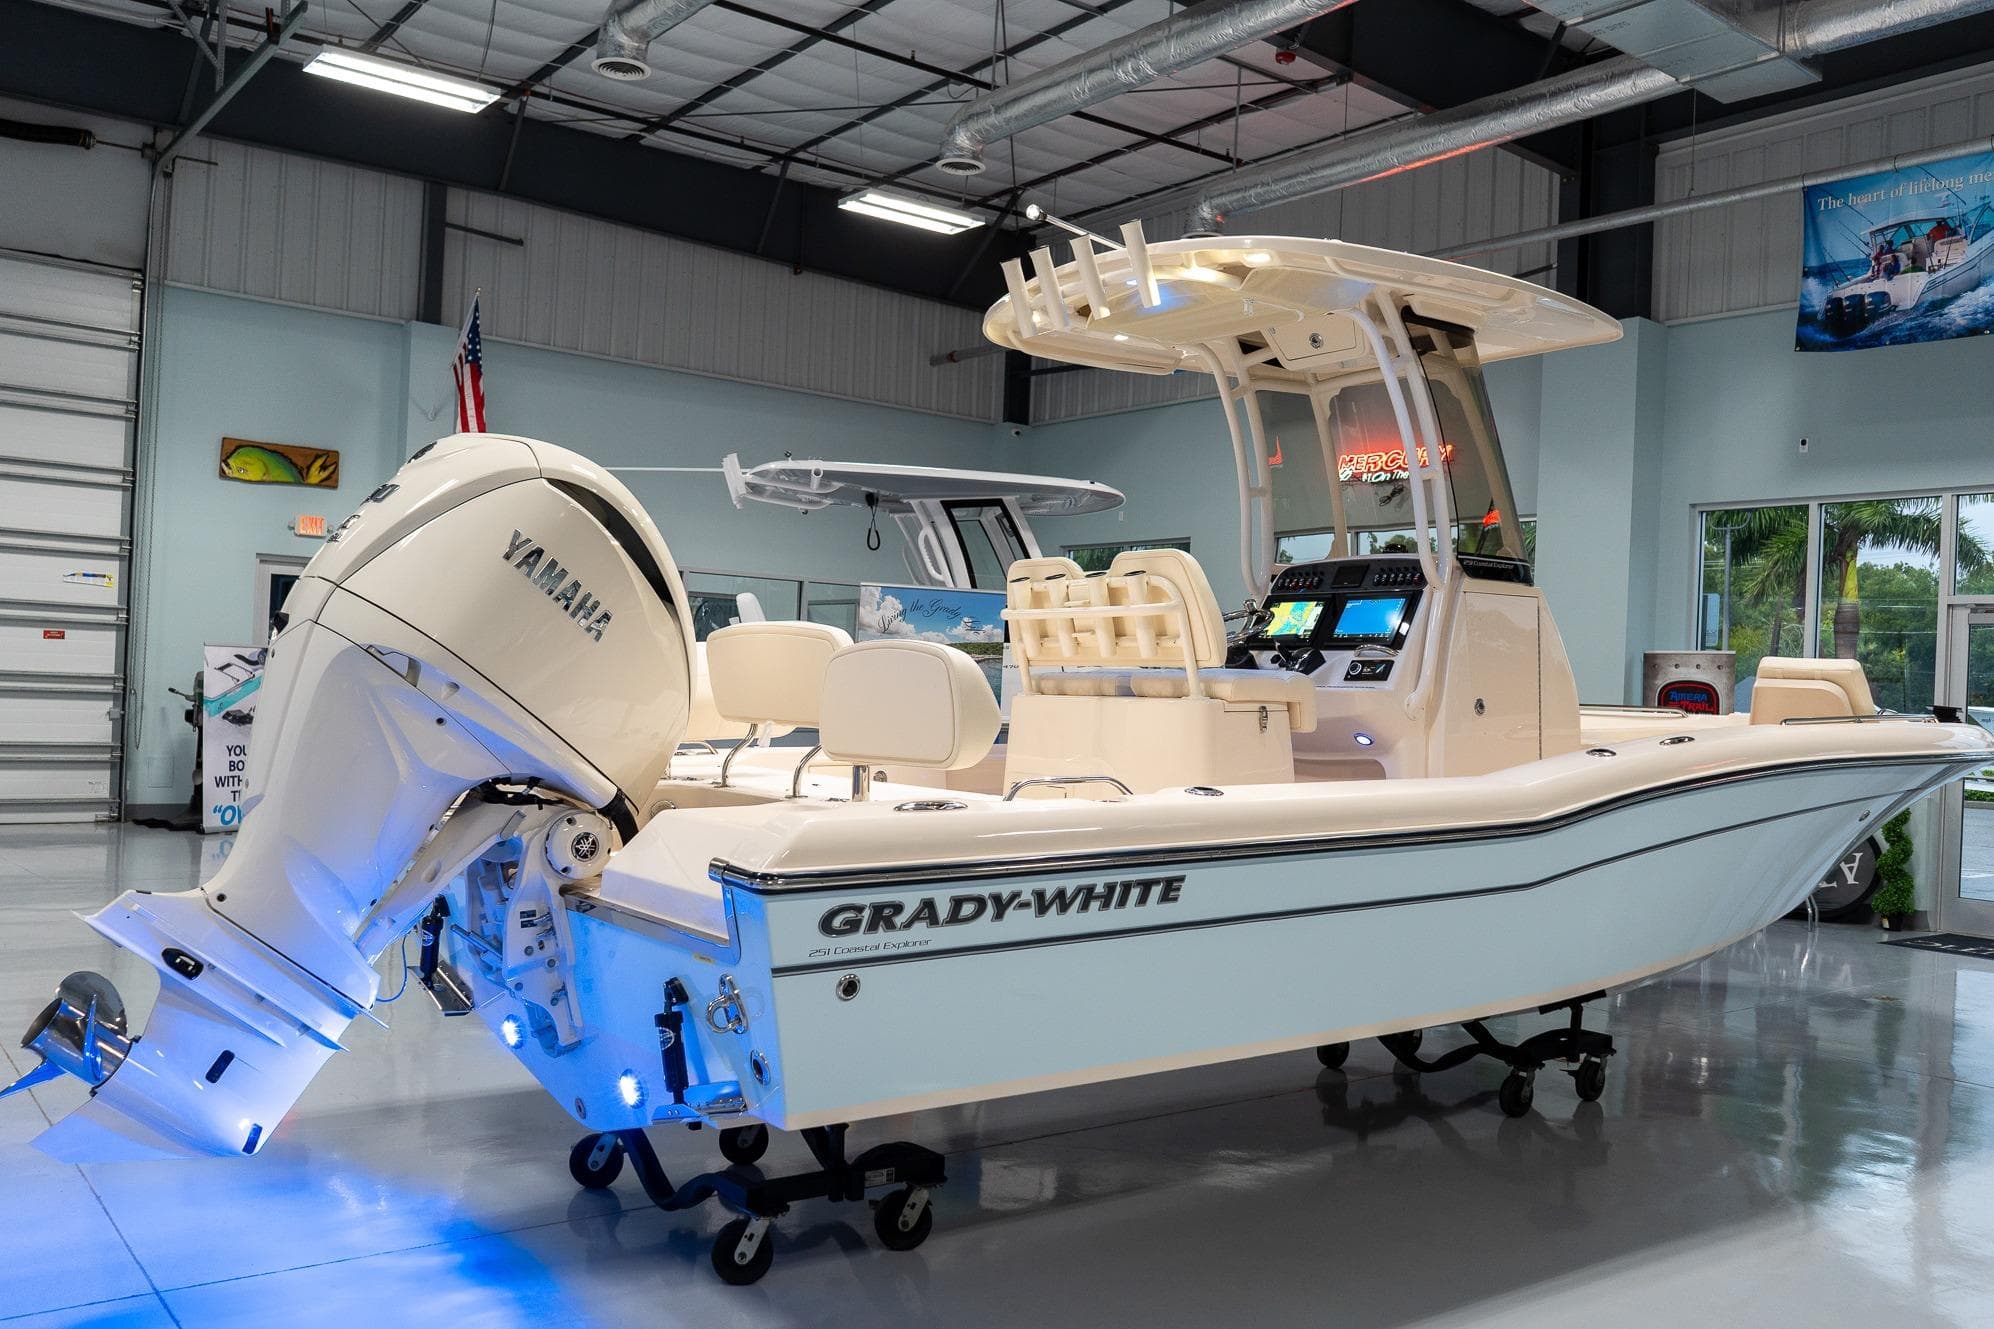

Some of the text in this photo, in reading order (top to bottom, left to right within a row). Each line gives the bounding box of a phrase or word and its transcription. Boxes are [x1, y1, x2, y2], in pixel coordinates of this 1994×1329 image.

[1817, 194, 1845, 211] The
[1848, 190, 1885, 206] heart
[1890, 181, 1905, 198] of
[1908, 175, 1964, 195] lifelong
[502, 528, 613, 643] YAMAHA
[877, 608, 907, 634] Living
[910, 599, 924, 613] the
[922, 599, 961, 620] Grady
[818, 874, 1187, 938] GRADY-WHITE
[808, 939, 932, 957] 251 Coastal Explorer
